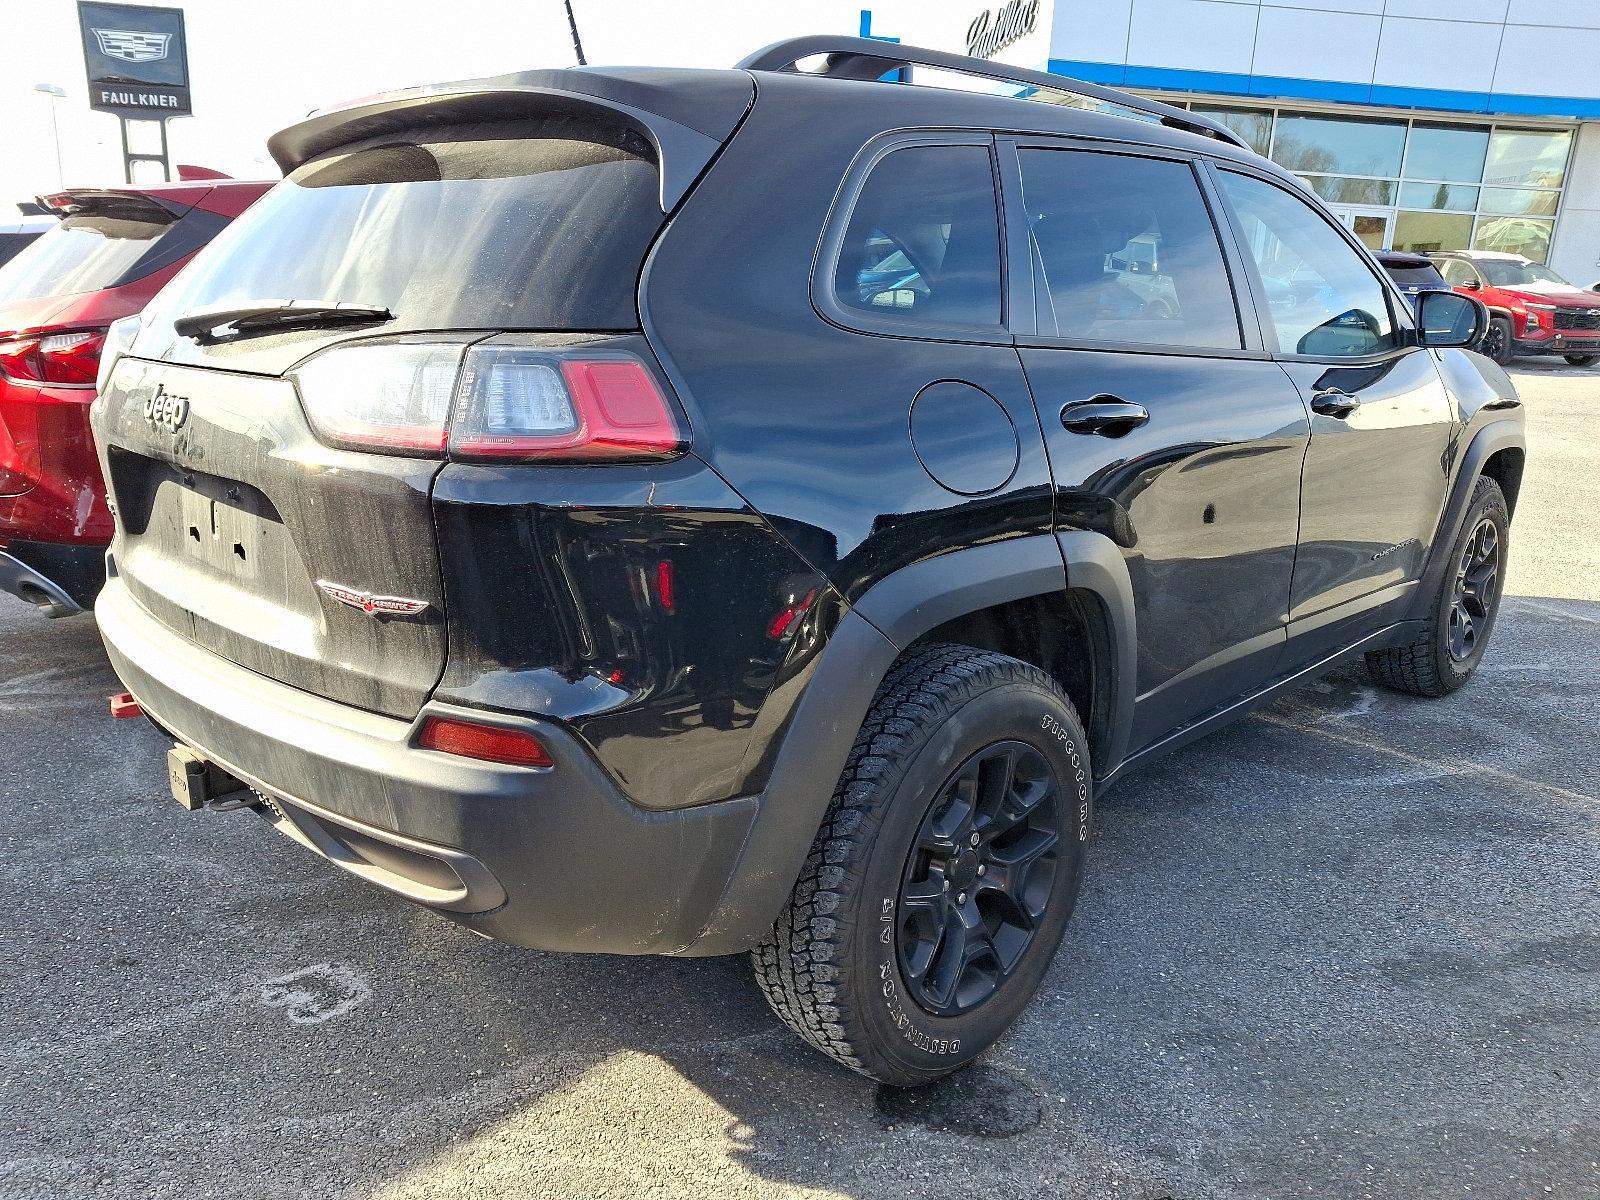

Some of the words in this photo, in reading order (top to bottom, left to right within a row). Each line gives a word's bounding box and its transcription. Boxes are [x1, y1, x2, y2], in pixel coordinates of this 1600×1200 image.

[101, 91, 178, 107] FAULKNER
[143, 383, 190, 434] Jeep
[879, 960, 961, 1054] DESTINATION
